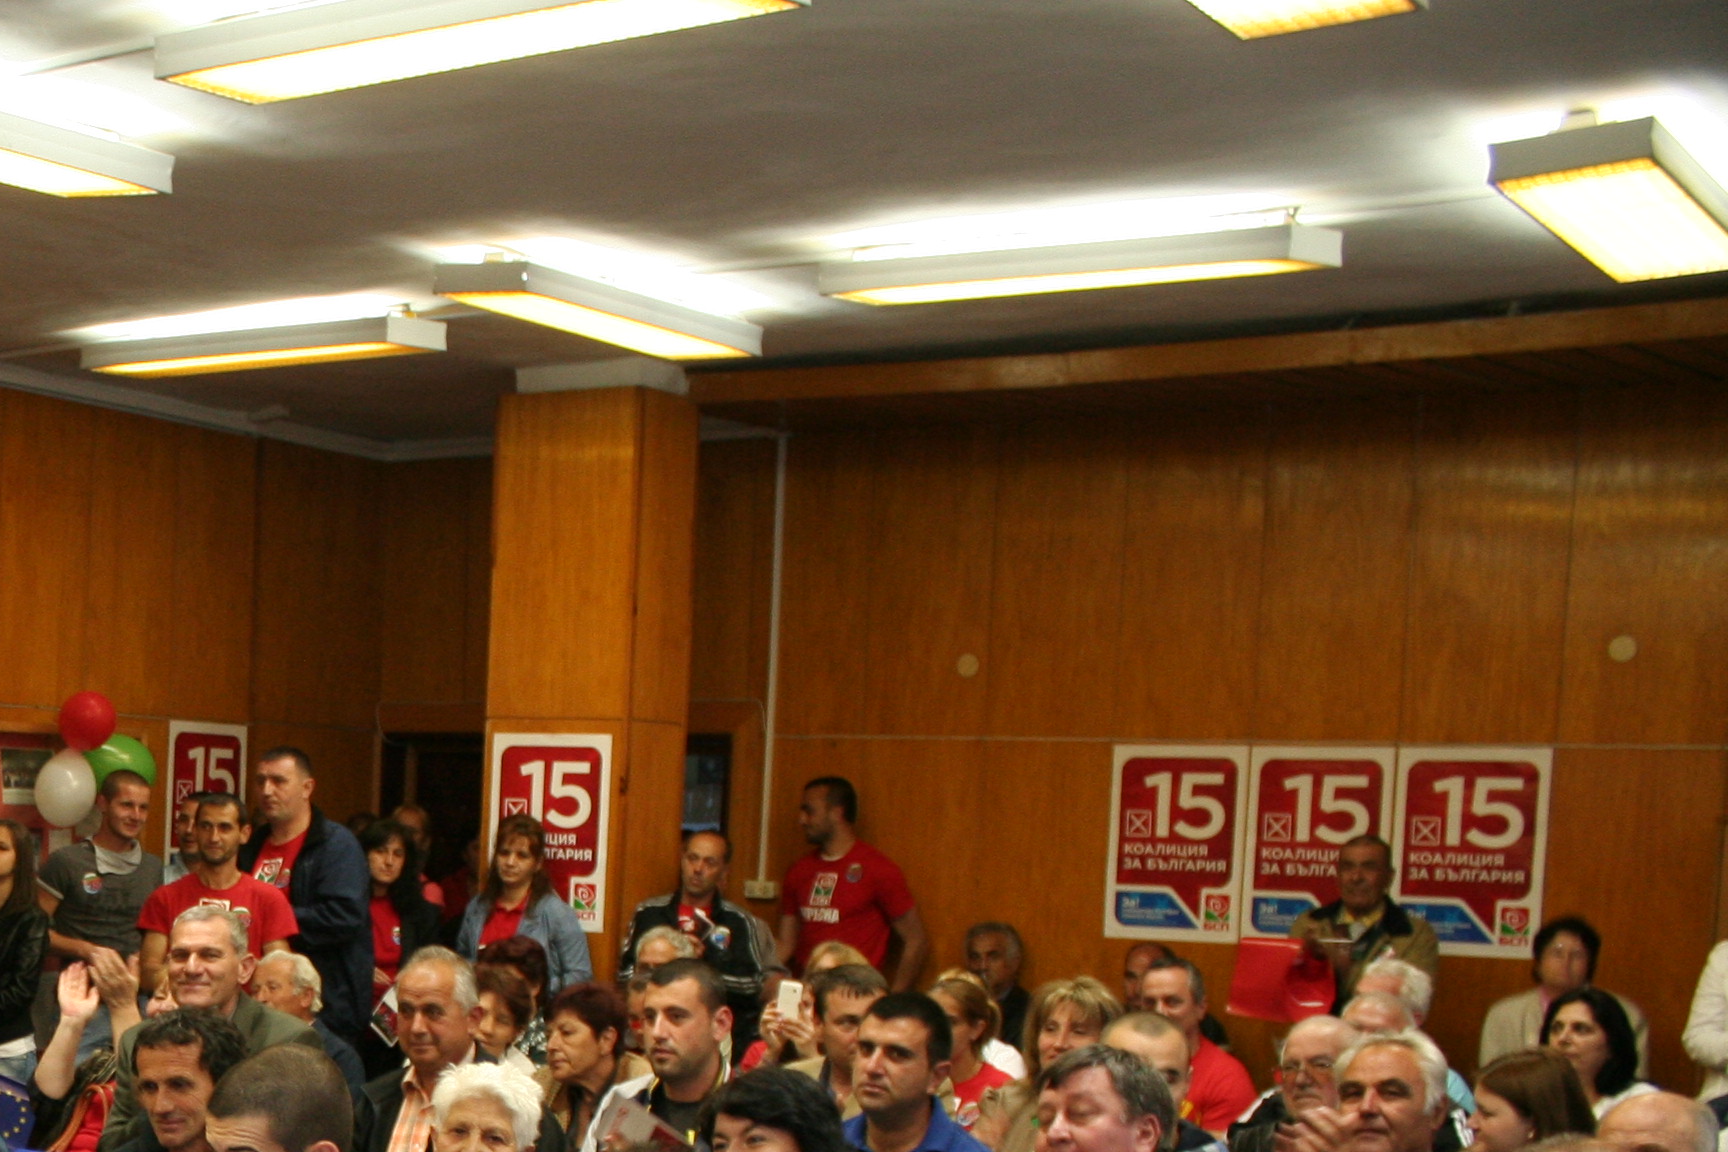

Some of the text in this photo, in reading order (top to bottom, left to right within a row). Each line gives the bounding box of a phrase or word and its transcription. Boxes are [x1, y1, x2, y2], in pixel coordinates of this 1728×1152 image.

[188, 746, 235, 794] 15
[520, 760, 592, 829] 15
[1144, 771, 1226, 841] 15
[1283, 773, 1370, 844] 15
[1432, 775, 1525, 850] 15
[544, 848, 593, 862] ГАРИЯ
[1124, 843, 1209, 858] КОАЛИЦИЯ
[1261, 847, 1340, 863] КОАЛИЦИ
[1123, 857, 1227, 873] ЗА БЪЛГАРИЯ
[1409, 852, 1505, 867] КОАЛИЦИЯ
[1260, 863, 1338, 878] ЗА БЪЛГА
[1408, 867, 1525, 884] ЗА БЪЛГАРИЯ
